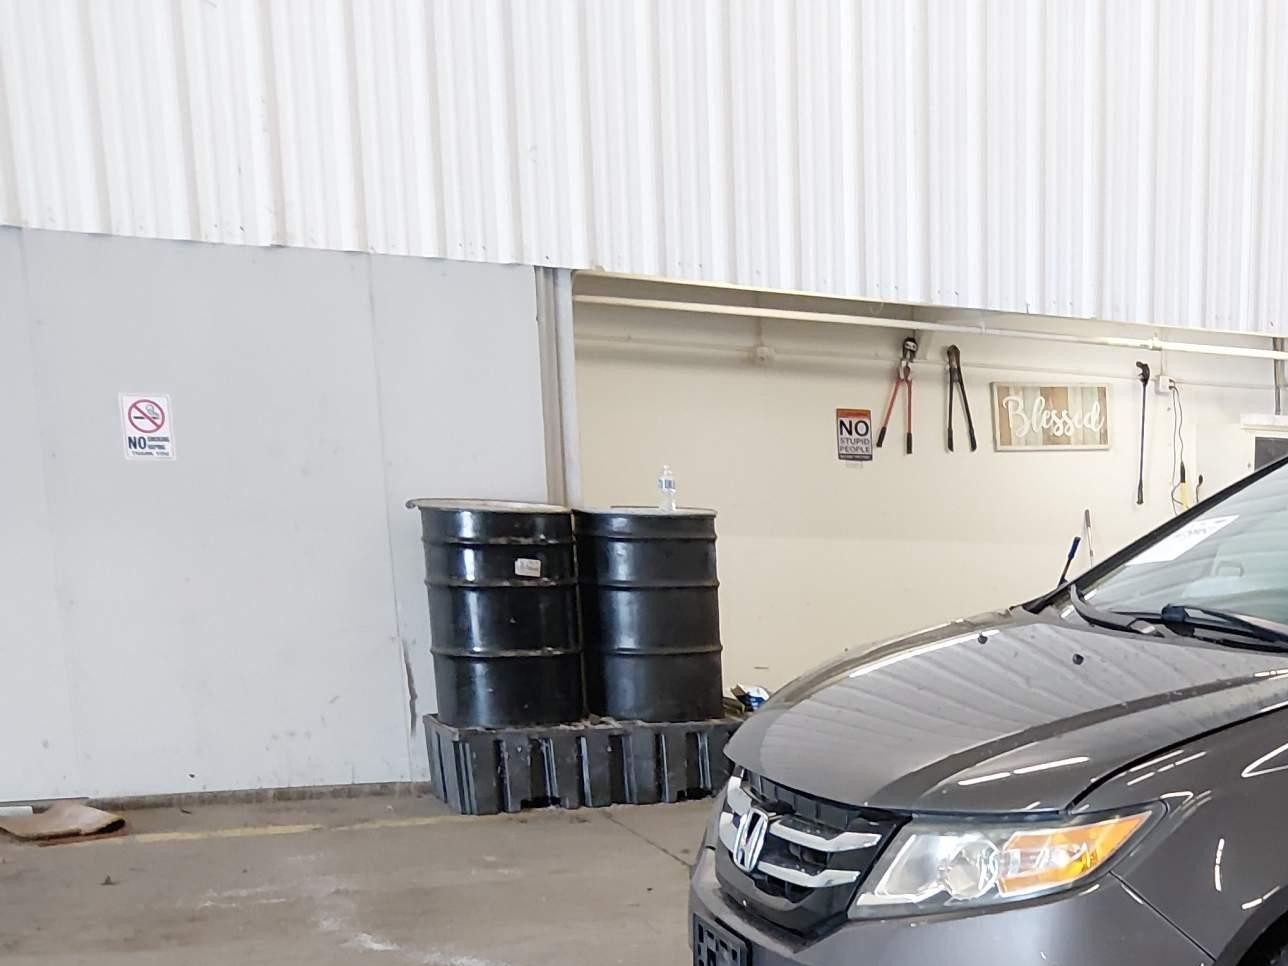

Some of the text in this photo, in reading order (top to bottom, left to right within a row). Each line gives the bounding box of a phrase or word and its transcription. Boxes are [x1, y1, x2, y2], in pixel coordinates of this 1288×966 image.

[1002, 396, 1104, 437] Blessed
[839, 419, 869, 437] NO
[127, 436, 147, 450] NO
[840, 437, 870, 446] STUPID
[840, 445, 870, 453] PEOPLE
